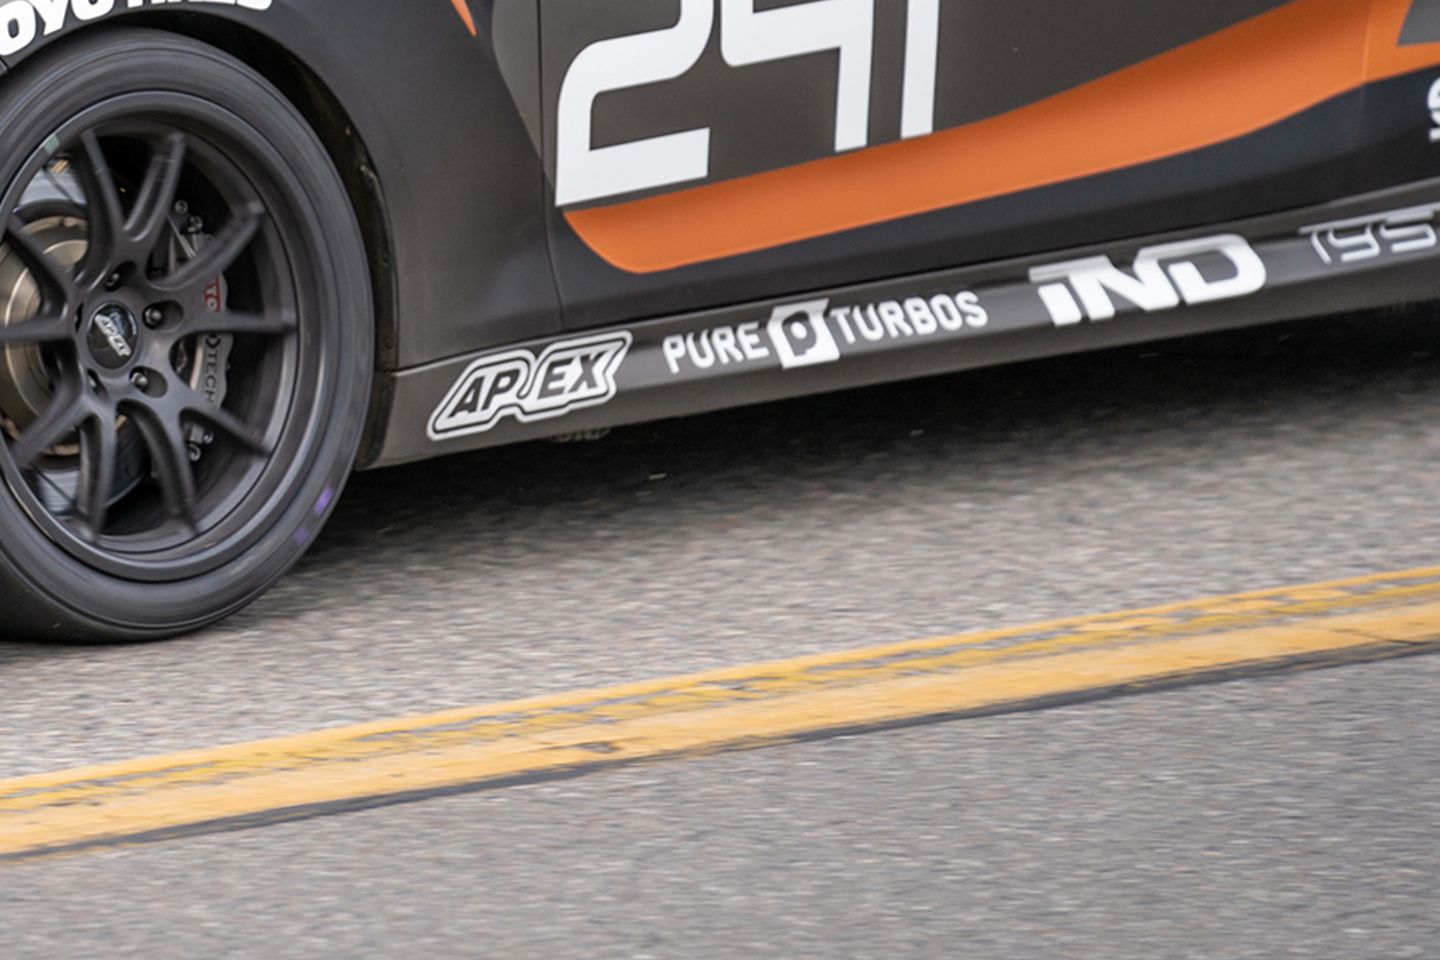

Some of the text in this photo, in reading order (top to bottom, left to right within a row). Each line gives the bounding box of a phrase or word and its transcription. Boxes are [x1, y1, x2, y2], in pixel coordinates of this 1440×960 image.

[663, 290, 990, 374] PURE TURBOS
[446, 345, 613, 418] APEX
